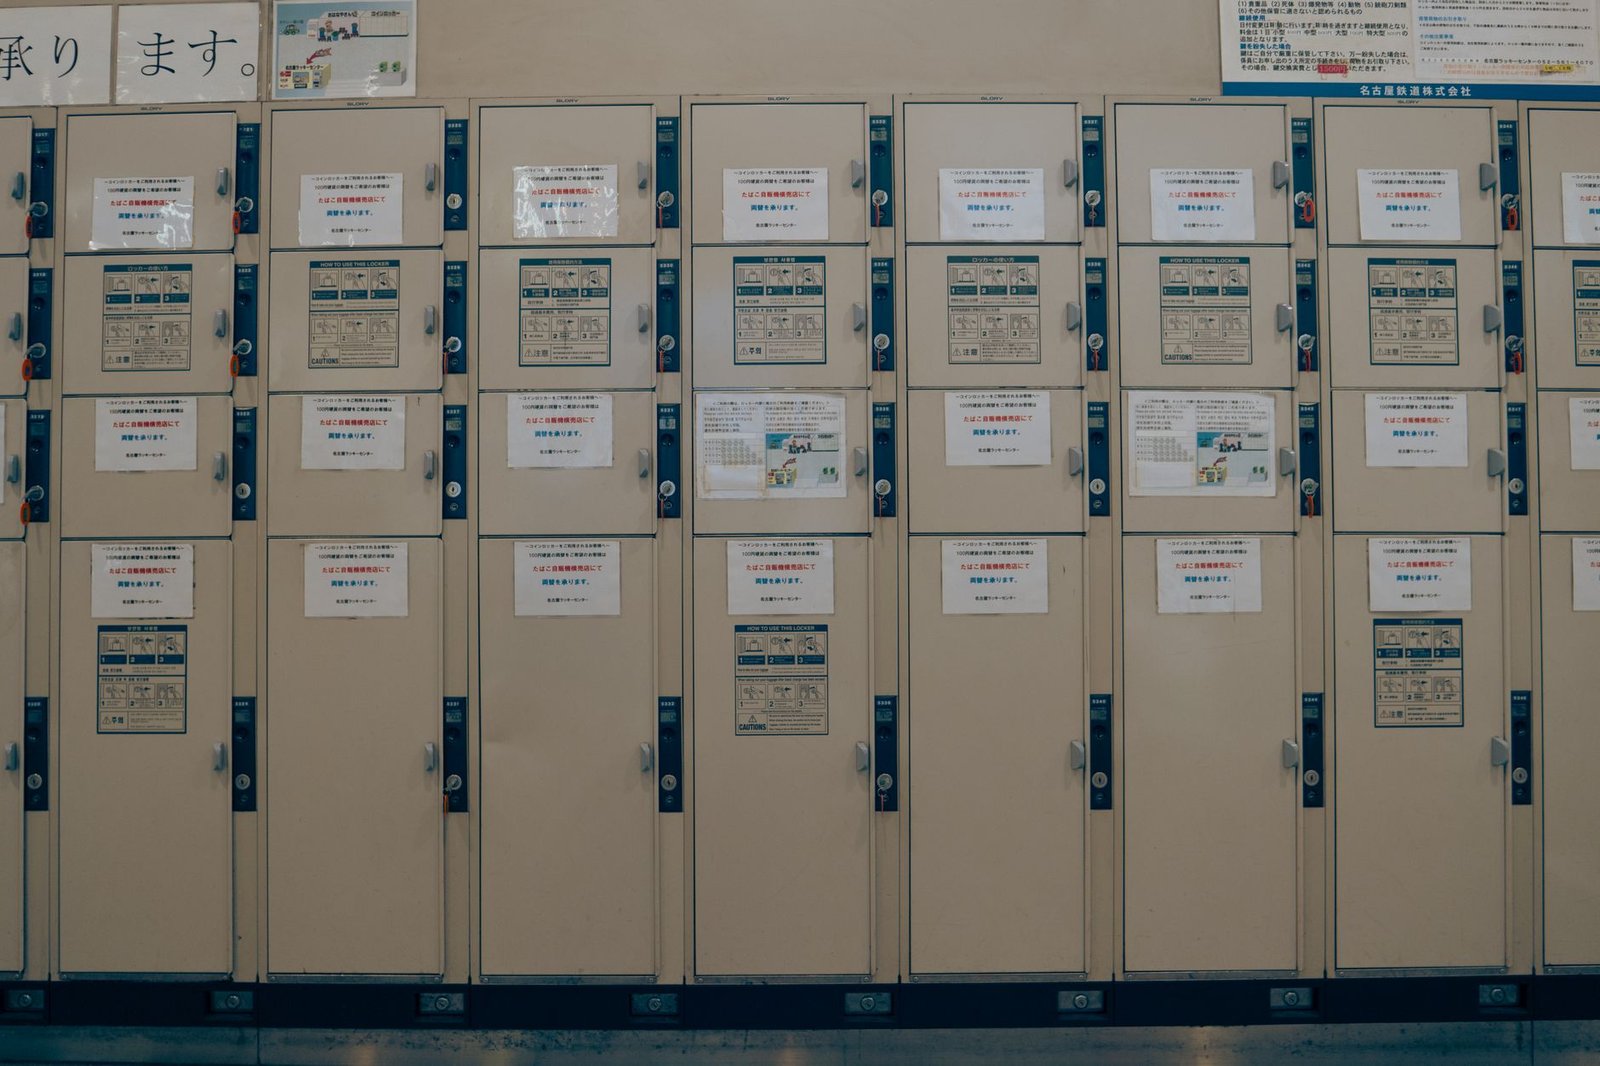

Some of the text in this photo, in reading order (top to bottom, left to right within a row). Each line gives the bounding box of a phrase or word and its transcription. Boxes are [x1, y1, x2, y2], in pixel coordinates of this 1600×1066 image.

[136, 29, 256, 78] ます。
[1360, 85, 1472, 97] 名古屋鉄道株式会社
